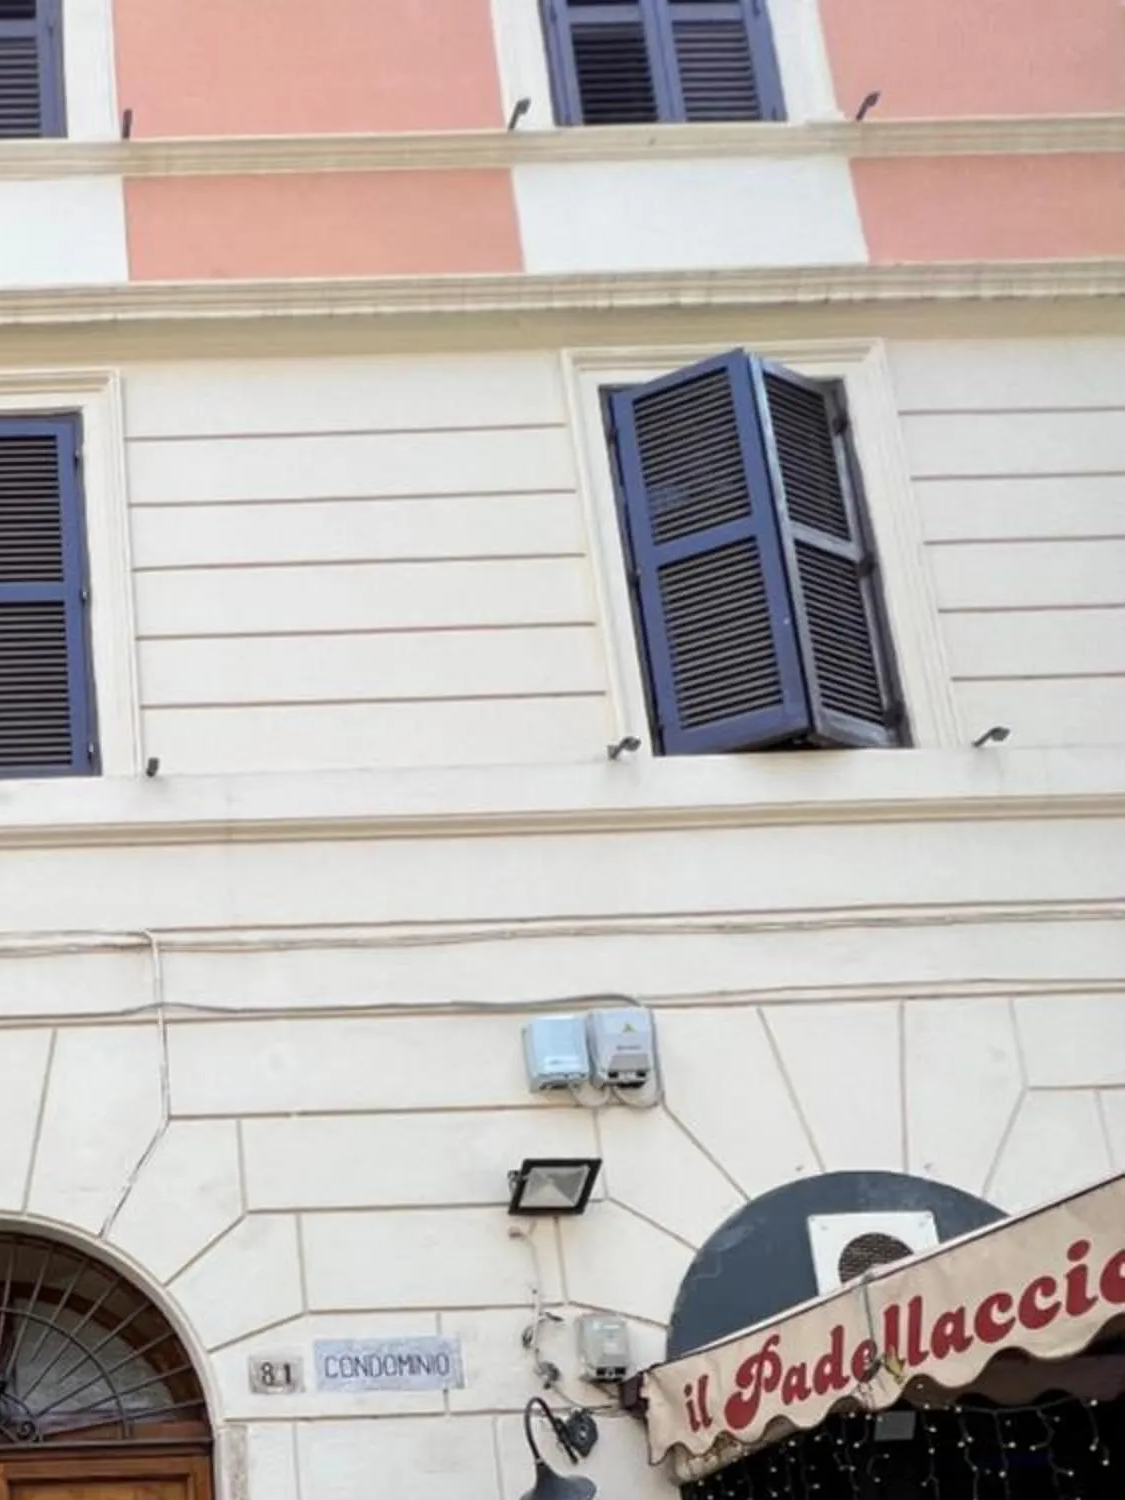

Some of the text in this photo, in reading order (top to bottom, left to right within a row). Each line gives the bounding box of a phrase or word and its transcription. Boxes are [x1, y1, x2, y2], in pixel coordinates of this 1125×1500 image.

[261, 1361, 292, 1387] 81
[324, 1353, 450, 1378] CONDOMINIO
[682, 1374, 713, 1433] il
